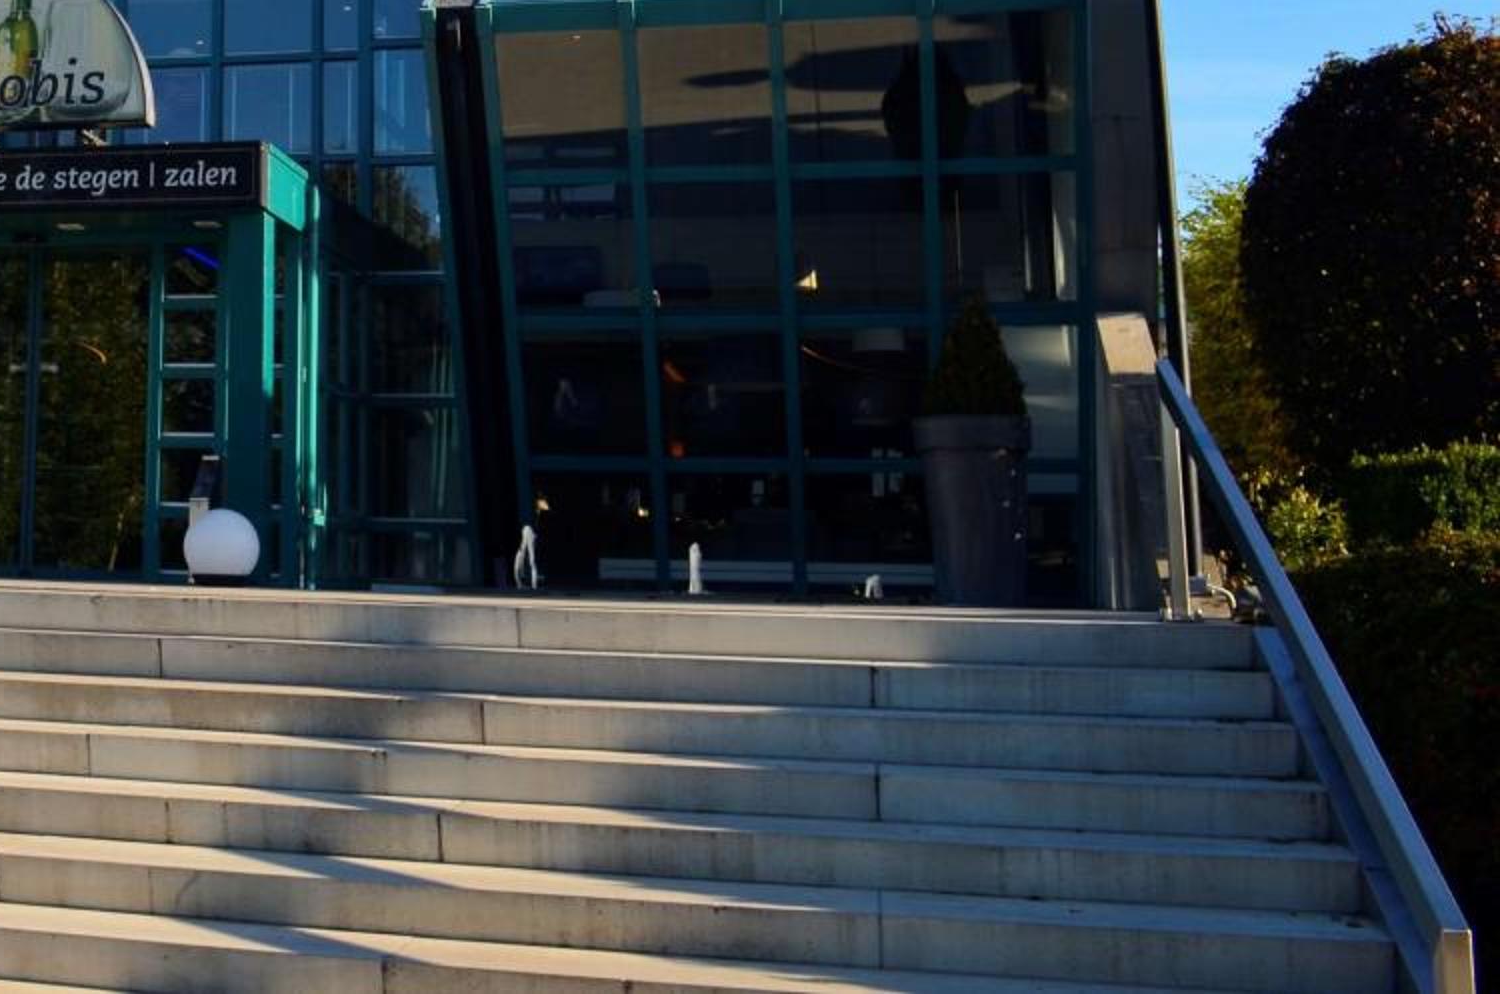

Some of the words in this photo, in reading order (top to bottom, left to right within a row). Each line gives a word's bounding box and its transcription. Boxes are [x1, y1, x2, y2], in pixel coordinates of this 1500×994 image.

[15, 164, 46, 191] de
[52, 167, 140, 197] stegen
[163, 160, 238, 187] zalen
